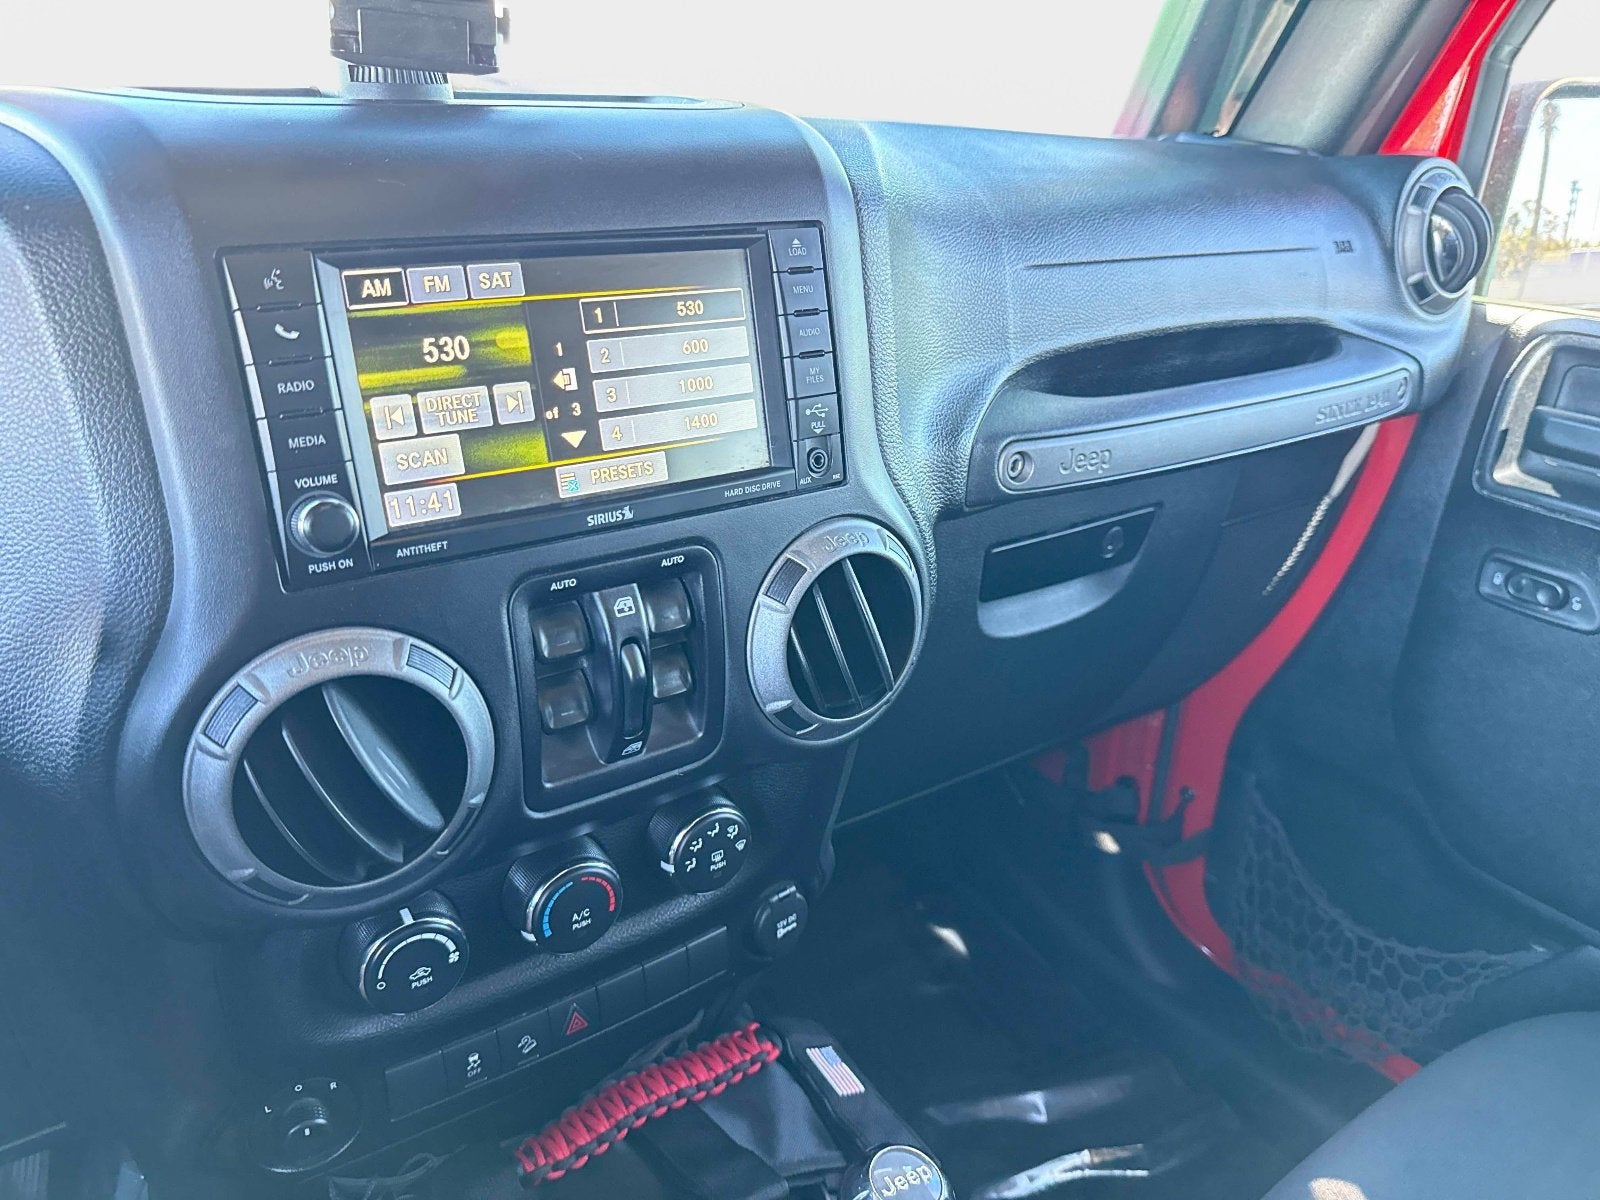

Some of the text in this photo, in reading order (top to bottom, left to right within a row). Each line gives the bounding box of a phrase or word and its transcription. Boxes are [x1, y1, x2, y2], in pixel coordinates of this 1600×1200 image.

[788, 247, 807, 257] LOAD
[361, 277, 392, 299] AM
[423, 274, 451, 293] FM
[479, 271, 512, 289] SAT
[792, 284, 814, 295] MENU
[594, 299, 704, 324] 1 530
[799, 327, 821, 337] AUDIO
[422, 334, 471, 364] 530
[555, 341, 564, 357] 1
[600, 338, 709, 364] 2 600
[806, 374, 824, 385] FILES
[809, 366, 820, 376] MY
[277, 379, 315, 395] RADIO
[606, 376, 714, 403] 3 1000
[424, 392, 481, 413] DIRECT
[544, 401, 582, 421] of 3
[435, 408, 479, 427] TUNE
[811, 420, 826, 430] PULL
[611, 412, 719, 442] 4 1400
[288, 434, 327, 450] MEDIA
[396, 447, 449, 471] SCAN
[1059, 448, 1113, 475] Jeep
[294, 473, 339, 490] VOLUME
[590, 461, 654, 485] PRESETS
[799, 475, 812, 486] AUX
[724, 479, 781, 498] HARD DISC DRIVE
[388, 488, 455, 520] 11:41
[586, 509, 624, 527] SIRIUS
[395, 540, 449, 559] ANTITHEFT
[823, 531, 870, 553] Jeep
[308, 557, 354, 575] PUSH ON
[661, 554, 685, 568] AUTO
[550, 577, 578, 592] AUTO
[286, 645, 369, 678] Jeep
[710, 859, 727, 872] PUSH
[572, 908, 591, 923] A/C
[572, 918, 592, 931] PUSH
[411, 975, 433, 990] PUSH
[467, 1067, 482, 1078] OFF
[329, 1081, 338, 1090] R
[264, 1105, 272, 1113] L
[881, 1164, 933, 1198] Jeep
